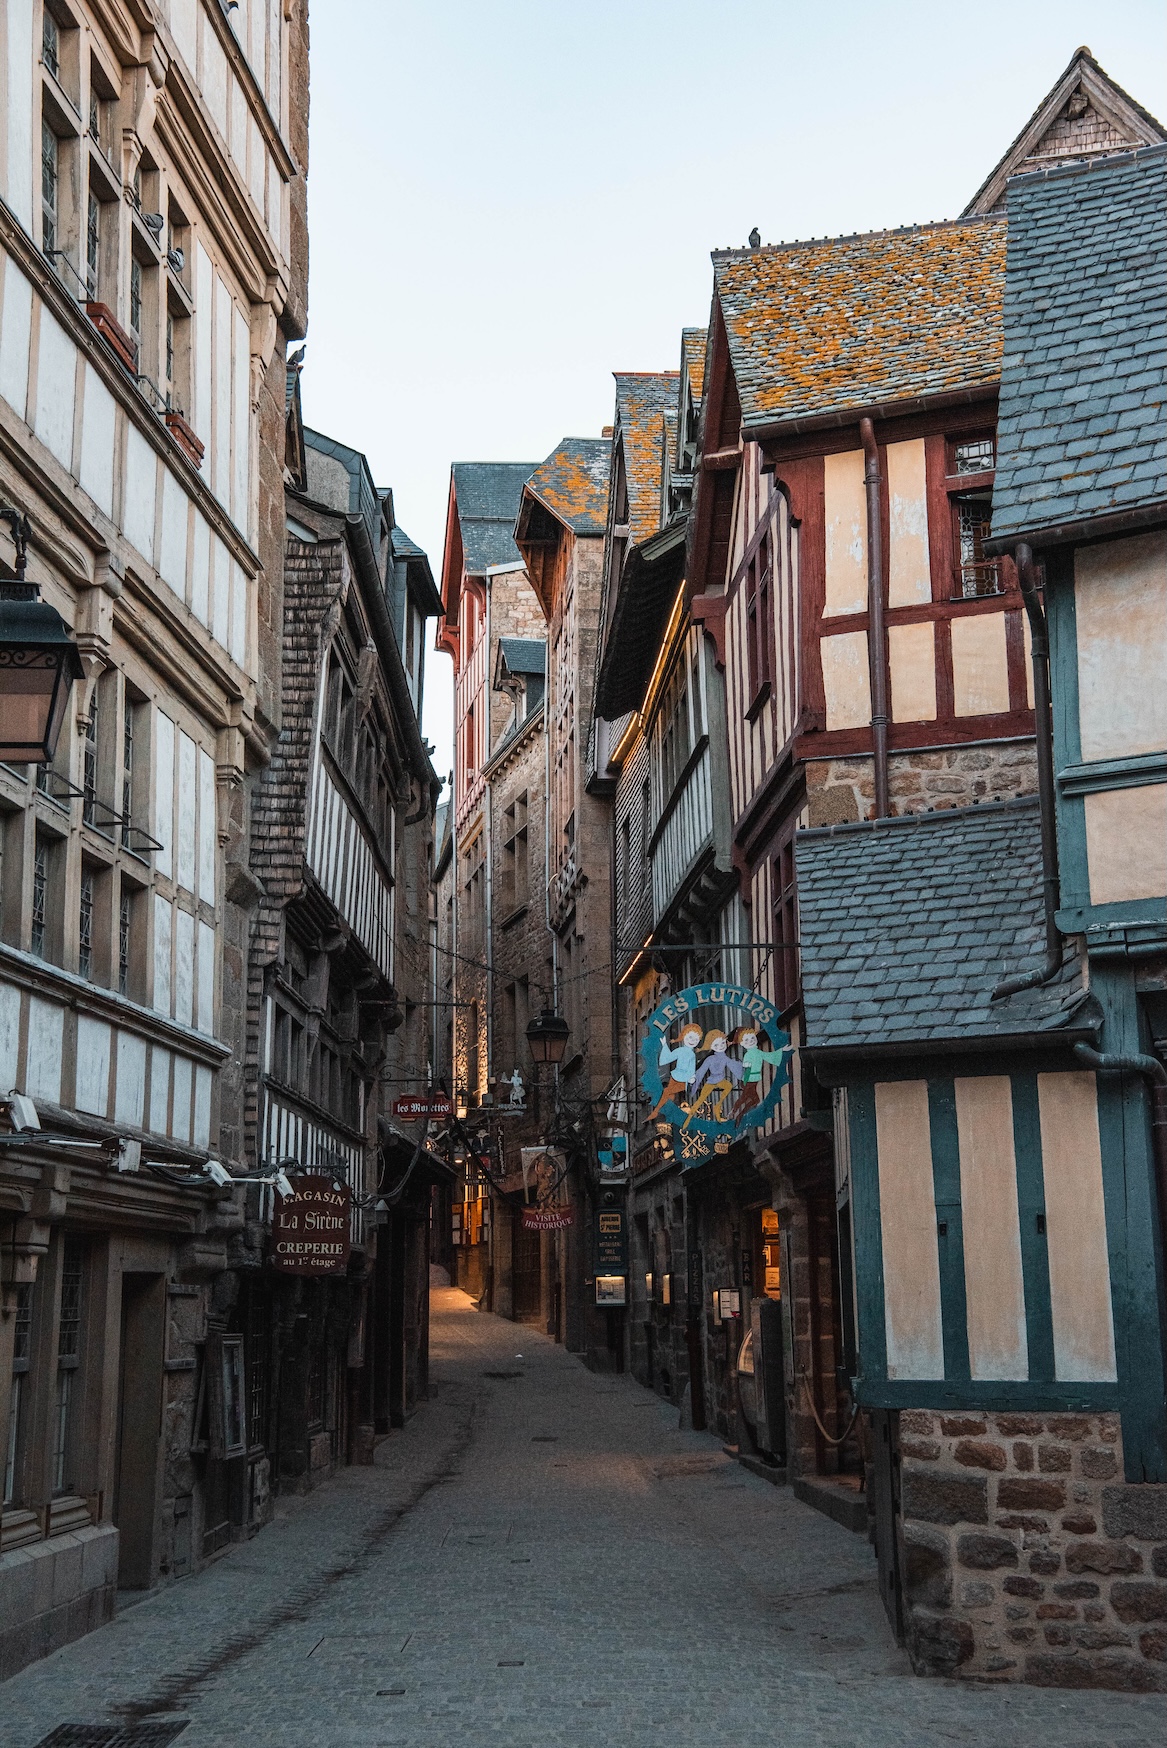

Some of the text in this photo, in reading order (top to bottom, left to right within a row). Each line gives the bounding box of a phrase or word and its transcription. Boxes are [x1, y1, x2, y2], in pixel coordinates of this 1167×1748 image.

[653, 996, 689, 1032] LES
[397, 1102, 450, 1113] les Moettes
[282, 1190, 346, 1207] MAGASIN
[278, 1211, 344, 1232] La Sirène
[525, 1218, 573, 1230] HISTORIQUE
[534, 1213, 562, 1223] VISITE
[276, 1242, 343, 1254] CREPERIE
[283, 1258, 295, 1266] au
[311, 1257, 336, 1268] étage
[742, 1252, 751, 1282] BAR
[691, 1253, 700, 1302] PIZZAS
